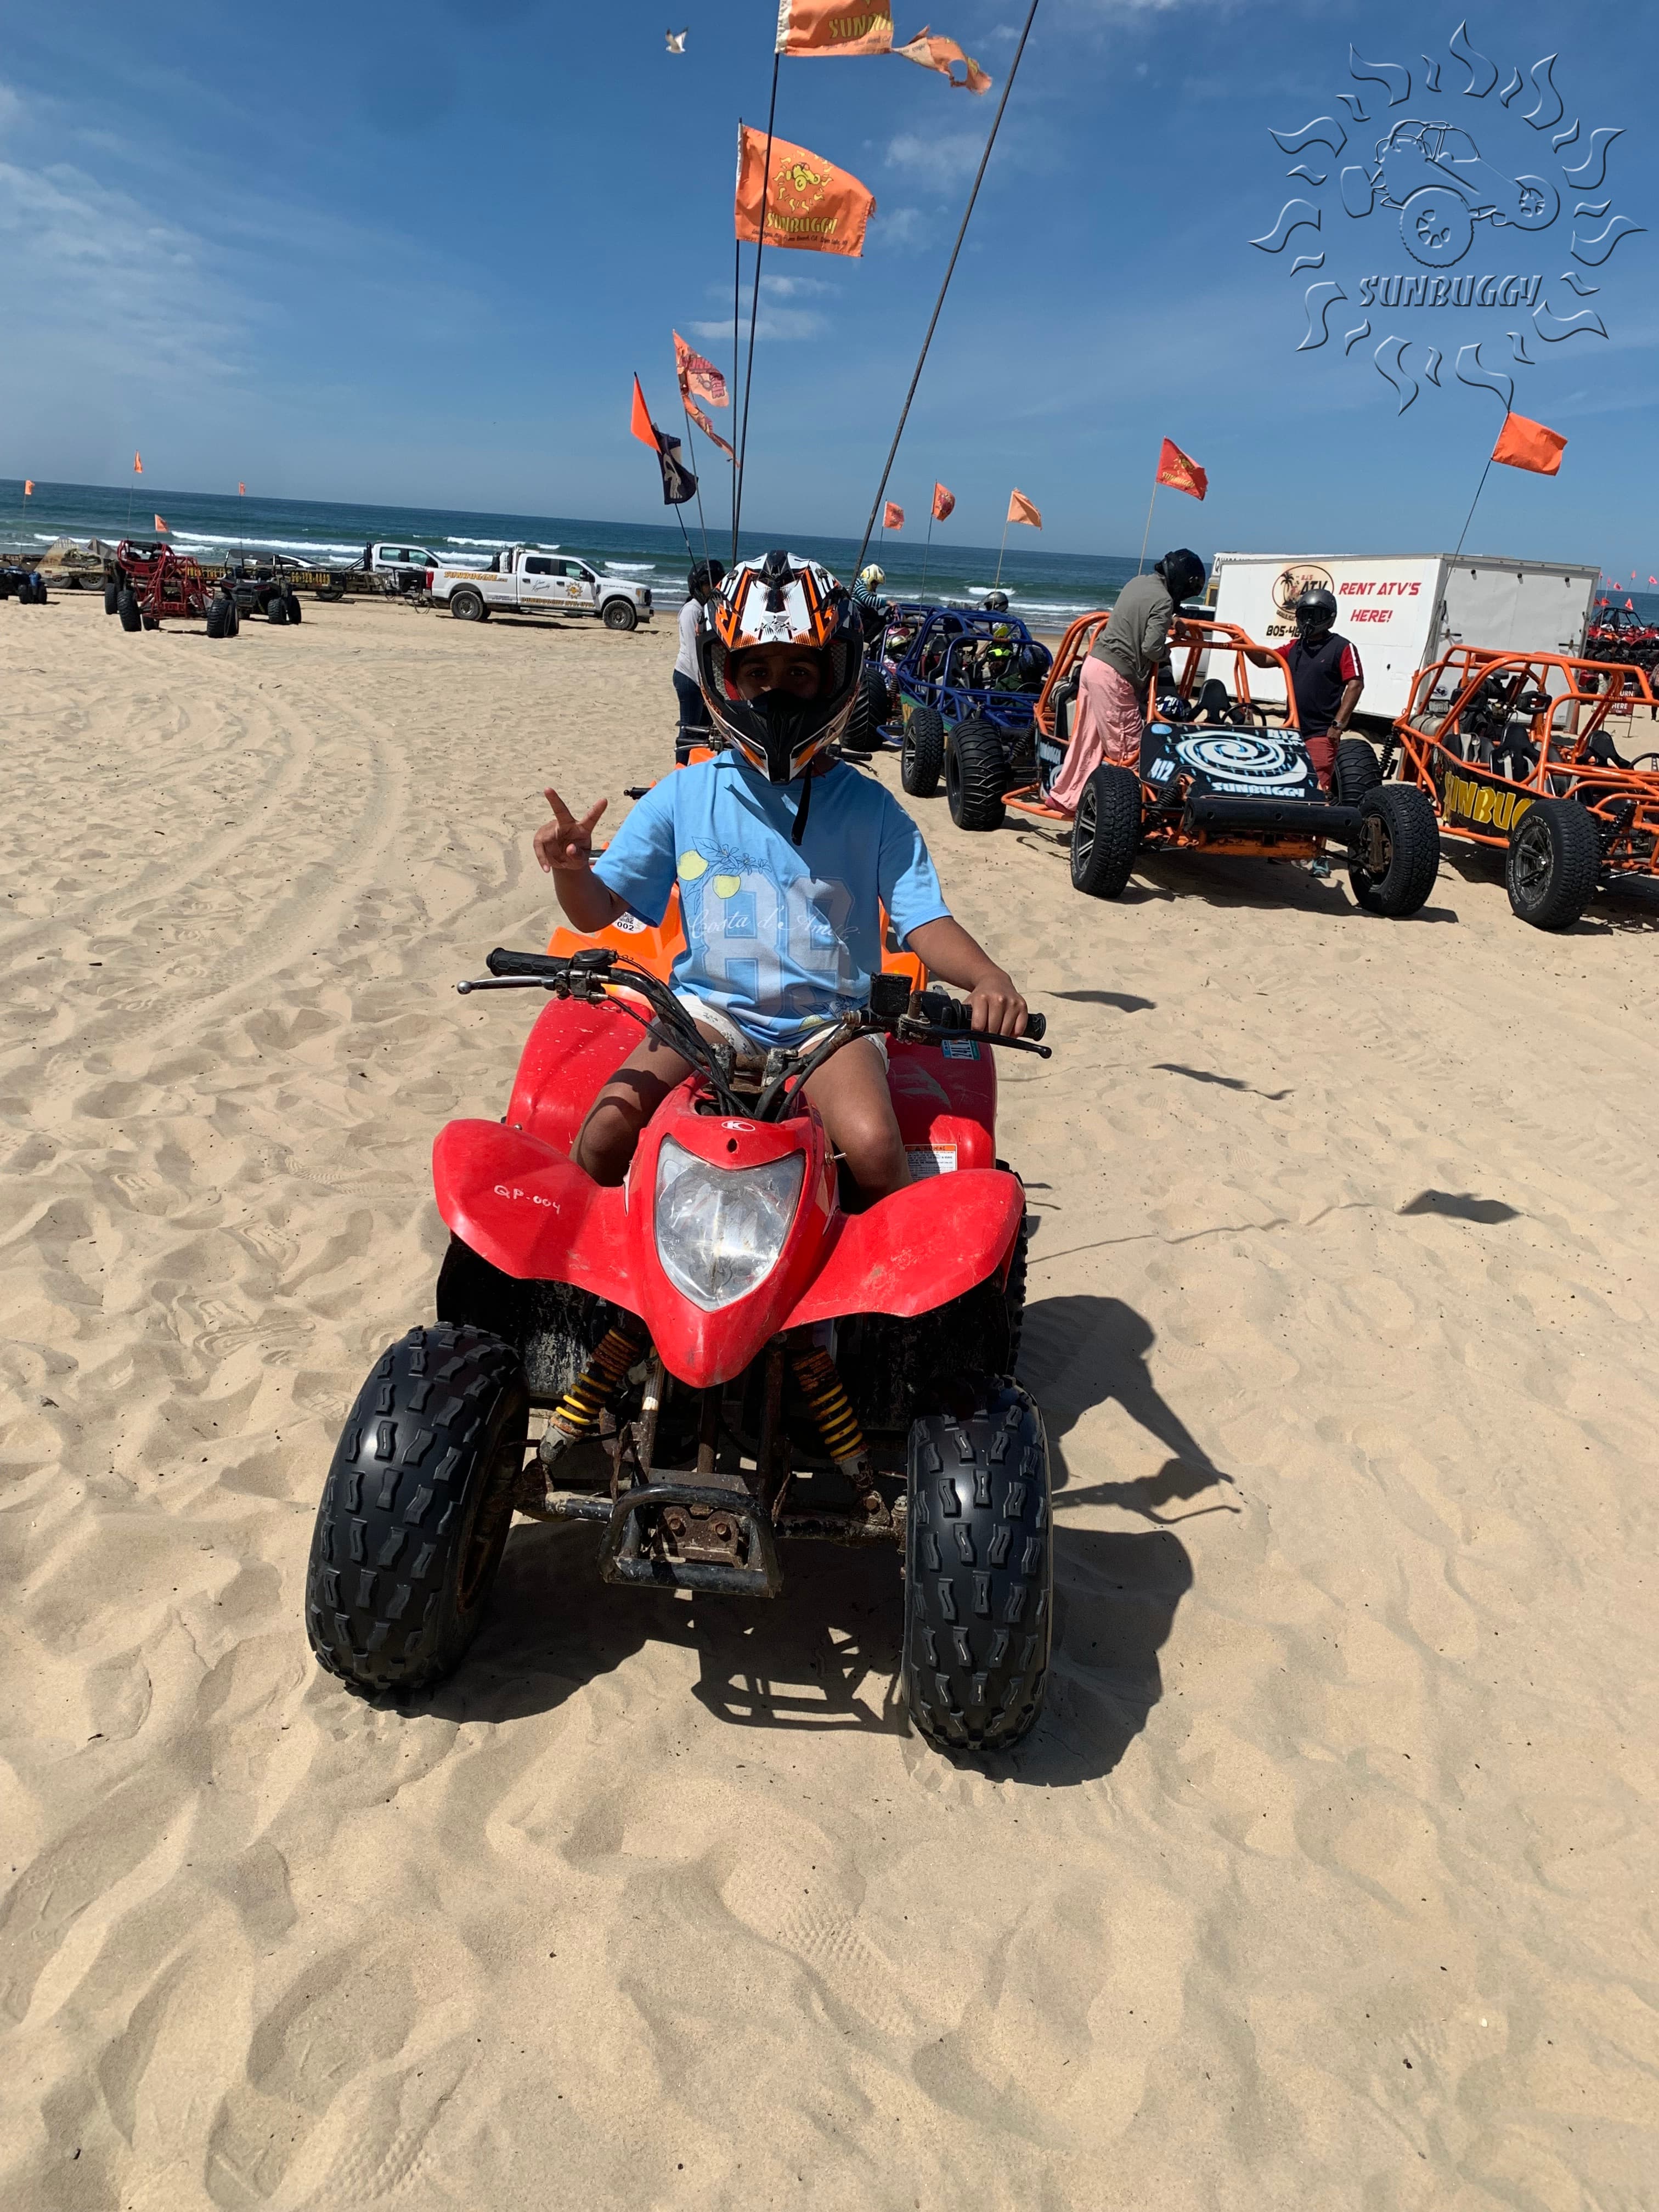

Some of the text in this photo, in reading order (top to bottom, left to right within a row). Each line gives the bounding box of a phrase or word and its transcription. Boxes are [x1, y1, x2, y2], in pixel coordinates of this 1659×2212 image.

[767, 212, 838, 234] SUNBUGGY
[1338, 583, 1422, 596] RENT ATV'S
[1350, 610, 1393, 623] HERE!
[1211, 782, 1306, 798] SUNBUGGY
[617, 921, 635, 932] 002
[687, 909, 751, 939] Costa
[494, 1184, 561, 1215] QP-004
